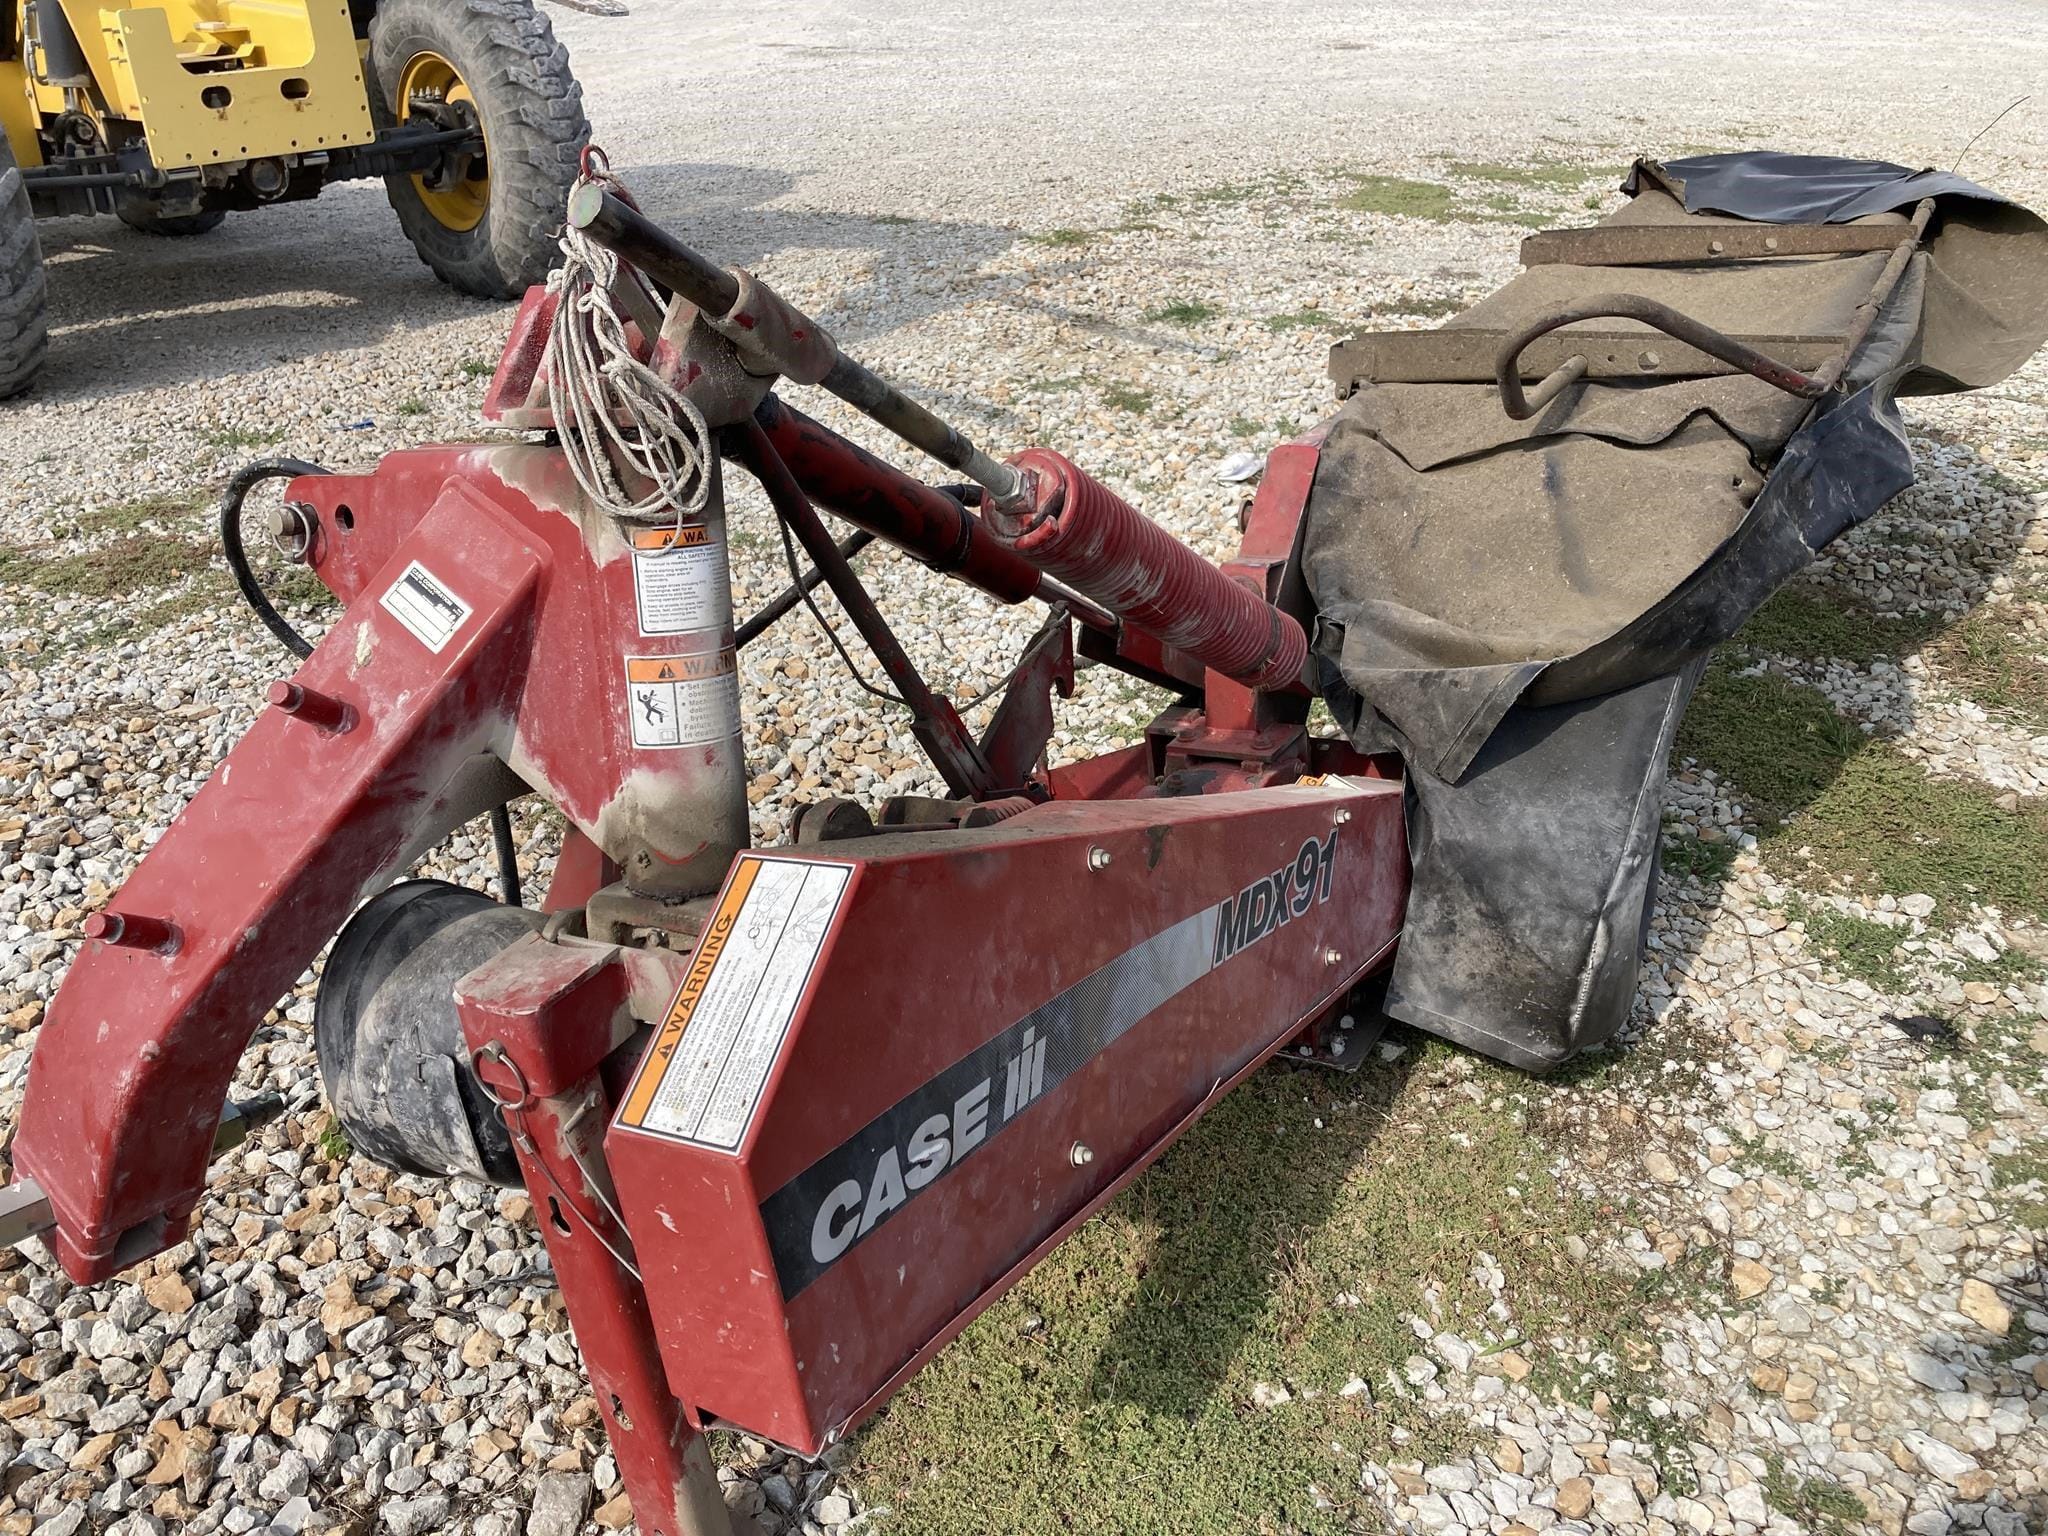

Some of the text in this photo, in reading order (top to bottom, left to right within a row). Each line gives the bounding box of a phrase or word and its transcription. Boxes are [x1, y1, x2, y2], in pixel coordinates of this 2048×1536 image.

[1213, 828, 1338, 969] MDX91
[666, 913, 732, 1033] WARNING
[811, 1077, 991, 1264] CASE
